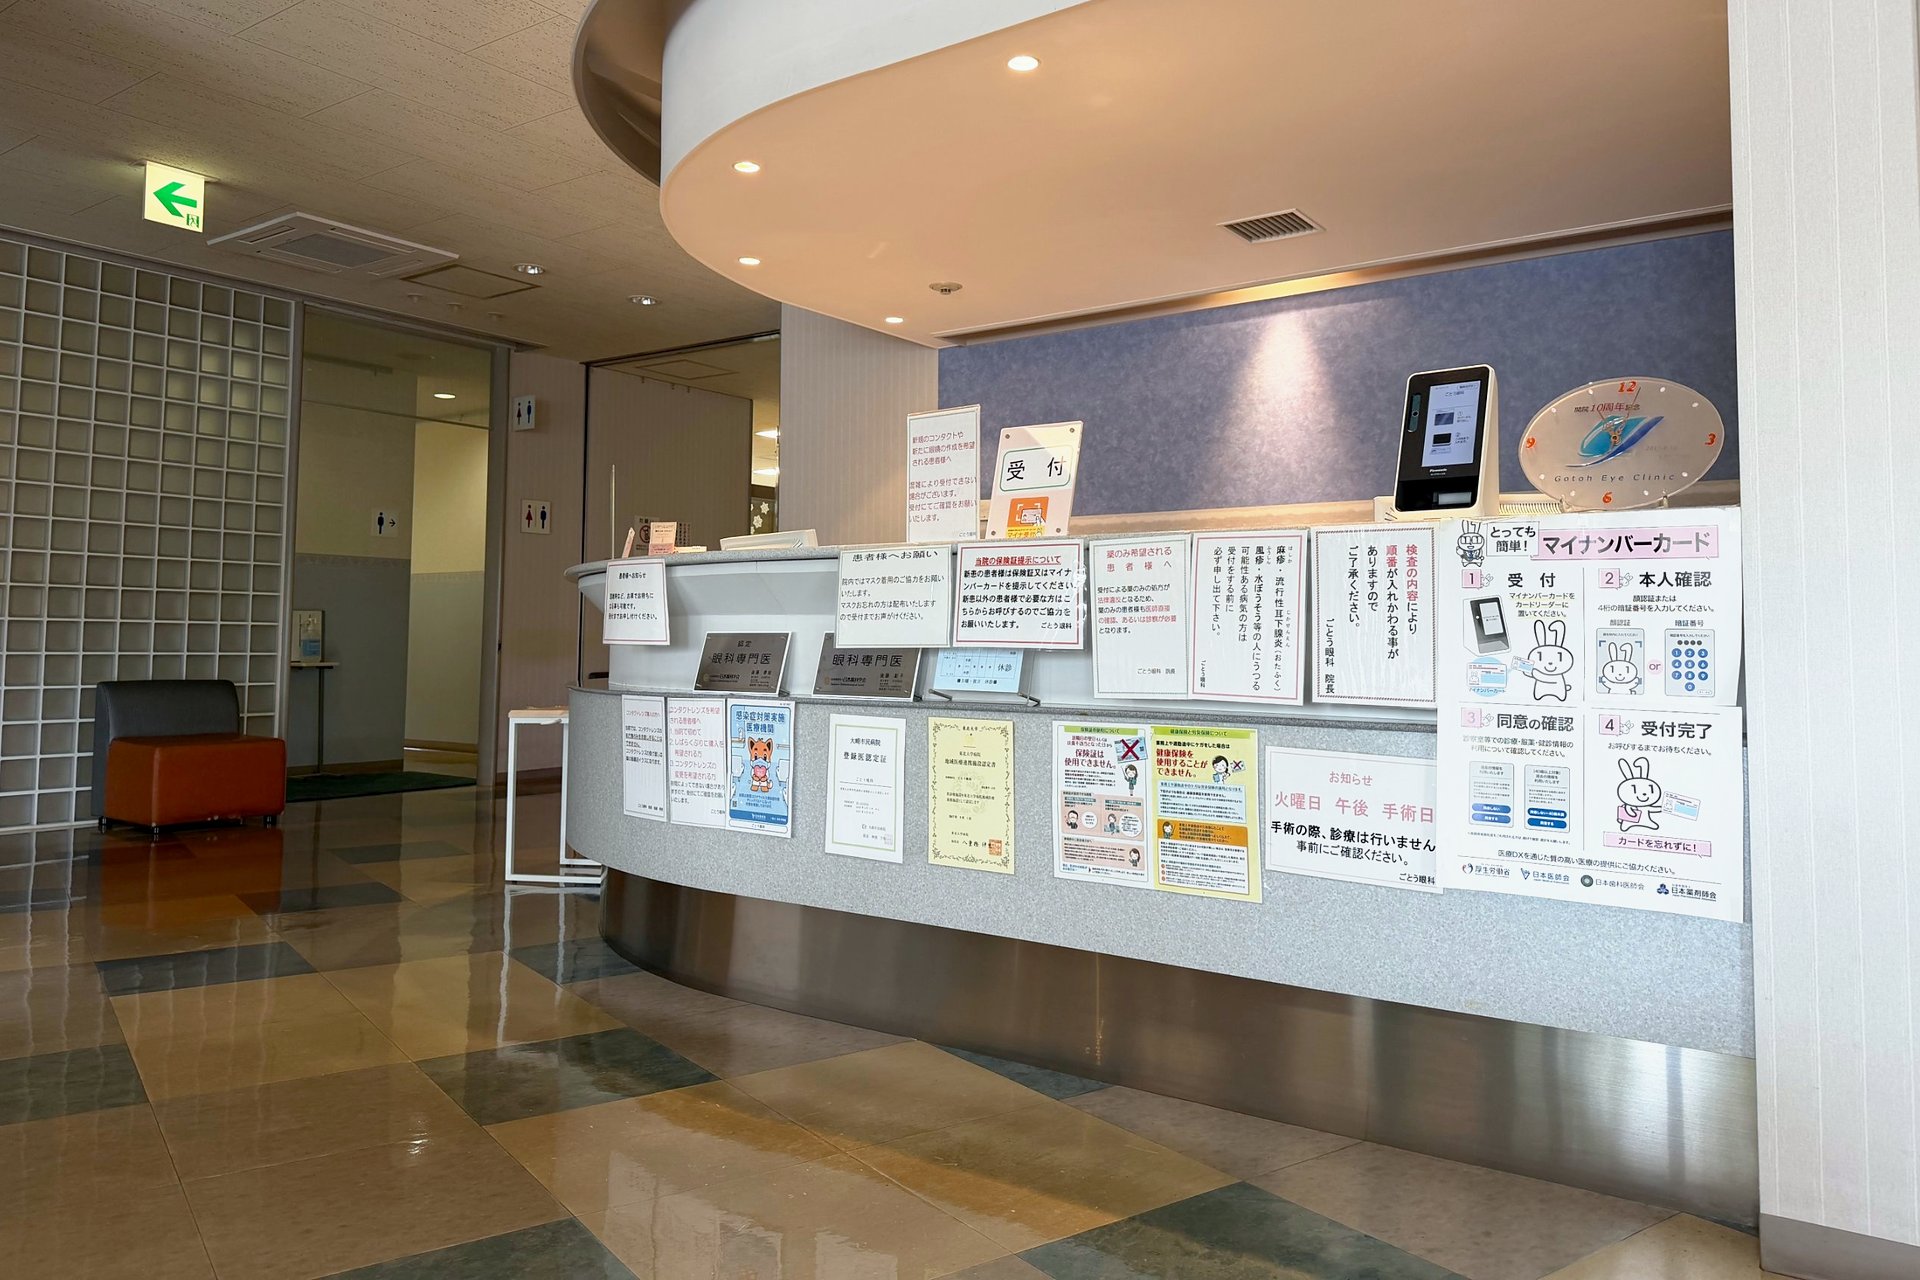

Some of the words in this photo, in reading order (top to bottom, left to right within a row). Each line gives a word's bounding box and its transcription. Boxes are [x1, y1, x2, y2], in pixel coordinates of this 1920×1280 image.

[1618, 381, 1637, 393] 12
[1574, 402, 1640, 413] 開院10周年記念
[1524, 437, 1536, 449] 9
[1704, 432, 1717, 446] 3
[912, 456, 952, 466] される患者様へ
[1006, 456, 1067, 481] 受付
[1554, 475, 1593, 483] Gotoh
[1601, 474, 1624, 483] Eye
[1633, 474, 1676, 482] Clinic
[1602, 492, 1613, 504] 6
[1490, 526, 1536, 538] とっても
[1496, 539, 1528, 553] 簡単！
[1543, 532, 1710, 555] マイナンバーカード
[852, 550, 938, 562] 患者様へお願い
[1106, 546, 1172, 558] 薬のみ希望される
[974, 556, 1062, 567] 当院の保険証提示について
[964, 568, 1072, 578] 新患の患者様は保険証又はマイナ
[1367, 545, 1378, 612] ありますので
[1468, 572, 1474, 585] 1
[1604, 572, 1614, 585] 2
[842, 574, 944, 586] 院内ではマスク着用のご協力をお願い
[1225, 546, 1236, 613] 受付をする前に
[1508, 573, 1556, 588] 受付
[1639, 571, 1712, 588] 本人確認
[1098, 584, 1170, 594] 受付による薬のみの処方が
[1212, 546, 1223, 636] 必ず申し出て下さい。
[1348, 545, 1360, 628] ご了承ください。
[1406, 544, 1418, 635] 検査の内容により
[962, 594, 1071, 604] 新患以外の患者様で必要な方はこ
[1238, 546, 1250, 642] 可能性ある病気の方は
[1509, 592, 1575, 600] マイナンバーカードを
[1633, 594, 1676, 602] 顔認証または
[840, 600, 936, 608] マスクお忘れの方は配布いたします
[1386, 544, 1399, 660] 順番が入れかわる事が
[1598, 604, 1714, 612] 4桁の暗証番号を入力してください。
[840, 612, 924, 620] ので受付までお声がけください。
[962, 608, 1071, 616] ちらからお呼びするのでご協力を
[961, 620, 1020, 629] お願いいたします。
[1252, 546, 1264, 691] 風疹・水ぼうそう等の人にうつる
[1099, 626, 1131, 634] となります。
[1324, 618, 1335, 667] ごとう眼科
[712, 652, 772, 664] 眼科専門医
[832, 654, 903, 667] 眼科専門医
[1324, 674, 1335, 694] 院長
[669, 706, 720, 714] コンタクトレンズを希望
[736, 710, 785, 722] 感染症対策実施
[1467, 711, 1475, 723] 3
[1497, 714, 1574, 732] 同意の確認
[746, 722, 774, 734] 医療機関
[1605, 718, 1615, 732] 4
[1641, 721, 1713, 740] 受付完了
[1076, 749, 1104, 758] 保険証は
[1156, 748, 1193, 758] 健康保険を
[1472, 745, 1566, 758] 利用について確認してください。
[1608, 742, 1712, 756] お呼びするまでお待ちください。
[844, 751, 887, 763] 登録医認定証
[1156, 758, 1208, 768] 使用することが
[1064, 758, 1116, 769] 使用できません。
[1158, 768, 1196, 778] できません。
[1328, 770, 1373, 786] お知らせ
[1274, 791, 1320, 811] 火曜日
[1335, 797, 1369, 817] 午後
[1382, 802, 1434, 824] 手術日
[1270, 820, 1436, 852] 手術の際、診療は行いません
[1618, 836, 1698, 853] カードを忘れずに！
[1296, 840, 1408, 866] 事前にご確認ください。
[1498, 849, 1677, 875] 医療DXを通じた質の高い医療の提供にご協力ください。
[1474, 865, 1510, 877] 厚生労働省
[1533, 871, 1570, 882] 日本医師会
[1399, 872, 1435, 885] ごとう眼科
[1595, 879, 1645, 890] 日本歯科医師会
[1672, 886, 1717, 900] 日本薬剤師会
